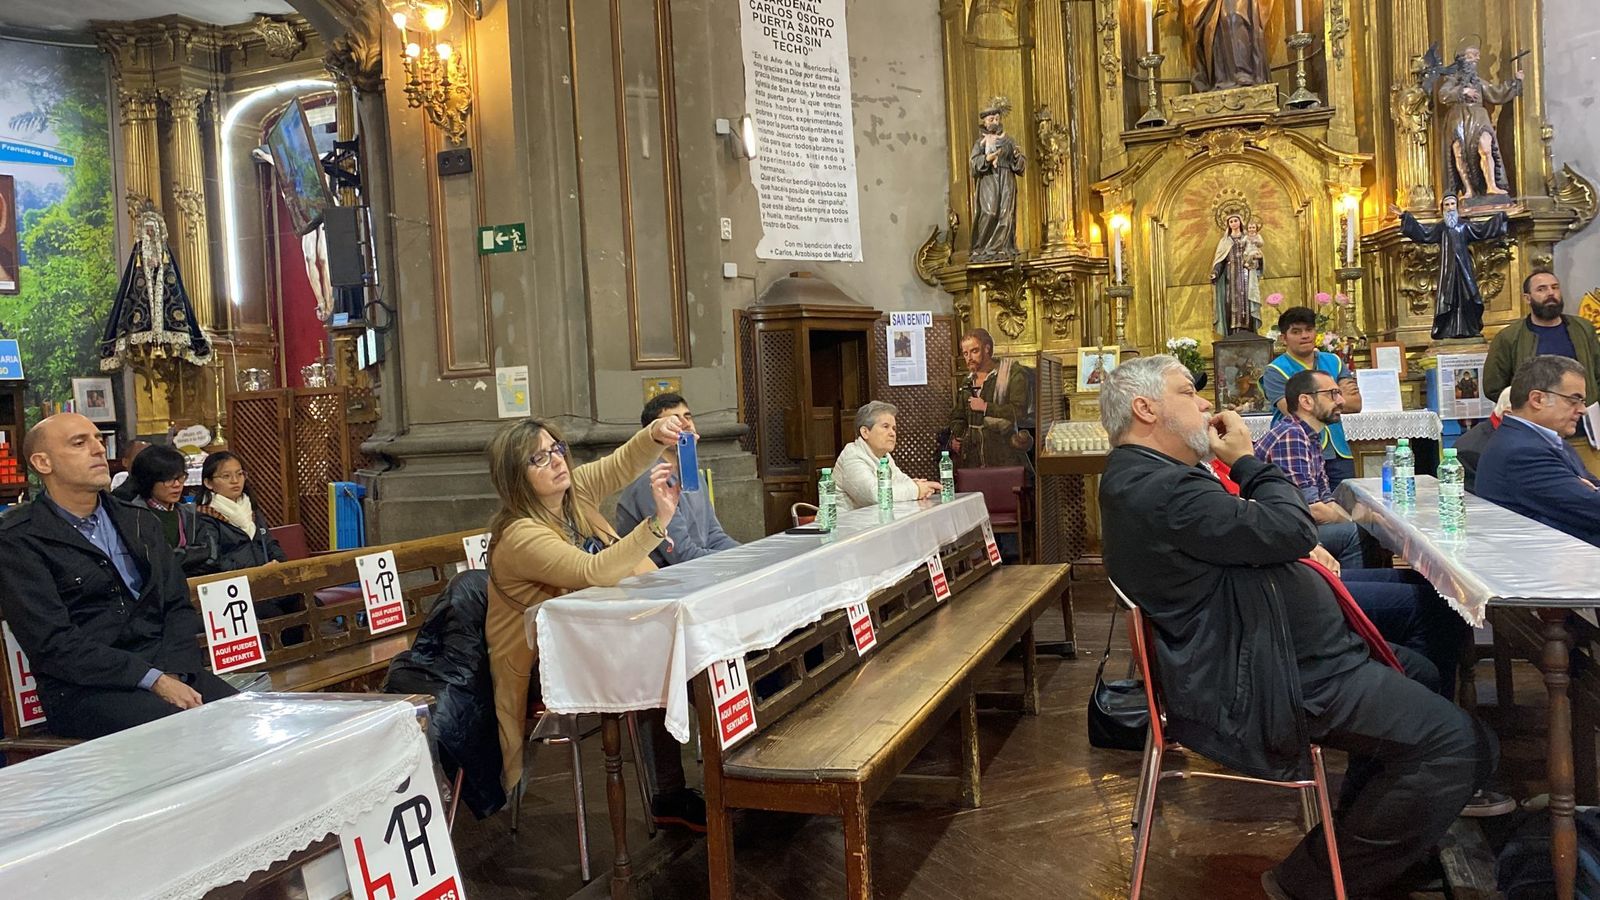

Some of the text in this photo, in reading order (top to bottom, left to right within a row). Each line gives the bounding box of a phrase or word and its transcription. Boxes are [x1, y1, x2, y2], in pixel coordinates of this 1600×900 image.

[750, 0, 834, 27] CARLOS OSORO
[764, 0, 819, 14] RDENAL
[753, 12, 832, 38] PUERTA SANTA
[764, 27, 821, 47] DE LOS SIN
[755, 70, 770, 79] gracia
[771, 75, 792, 84] inmensa
[764, 64, 783, 73] gracias
[790, 68, 802, 76] Dios
[768, 93, 784, 101] puerta
[779, 85, 789, 93] San
[816, 91, 840, 100] bendecir
[755, 98, 772, 108] tantos
[776, 104, 803, 113] hombres
[756, 108, 773, 117] pobres
[796, 116, 842, 126] experimentando
[776, 130, 805, 140] Jesucristo
[1, 144, 68, 162] Francisco Bosco
[760, 155, 805, 167] experimentado
[784, 214, 812, 222] manifieste
[892, 313, 930, 326] SAN BENITO
[0, 355, 19, 364] ARIA
[216, 640, 257, 656] AQUÍ PUEDES
[222, 651, 254, 664] SENTARTE
